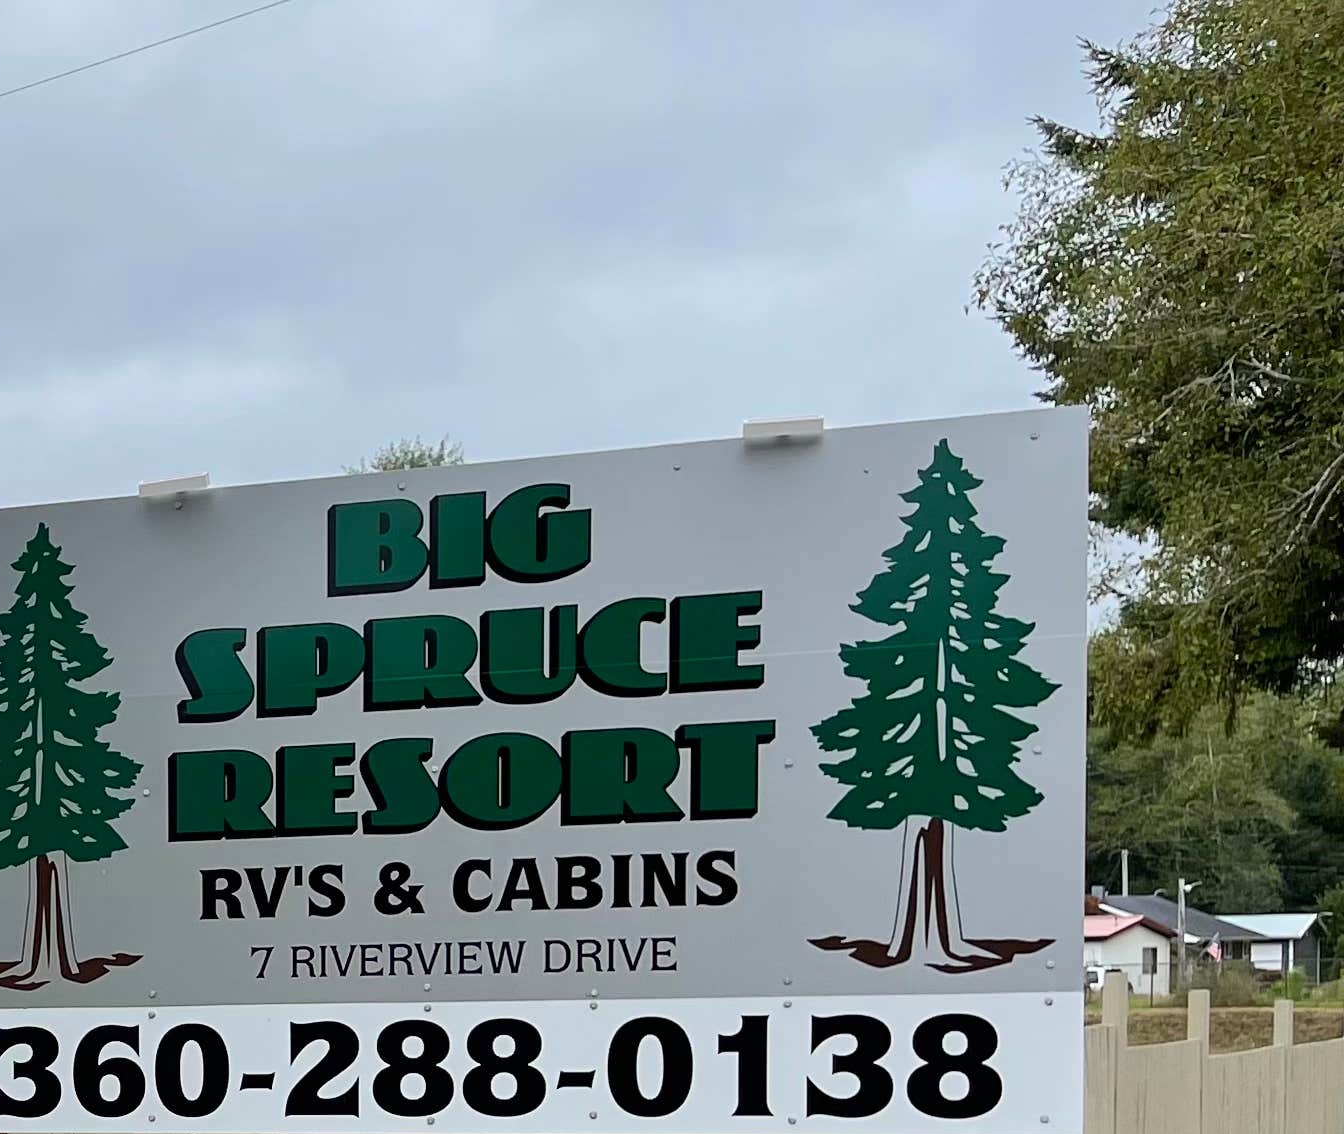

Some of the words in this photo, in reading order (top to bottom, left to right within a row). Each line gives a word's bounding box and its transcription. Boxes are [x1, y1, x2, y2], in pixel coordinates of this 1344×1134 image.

[327, 482, 592, 597] BIG
[174, 589, 766, 724] SPRUCE
[167, 719, 776, 842] RESORT
[198, 863, 347, 921] RV'S
[372, 861, 426, 916] &
[451, 849, 739, 914] CABINS
[249, 946, 275, 980] 7
[289, 939, 527, 979] RIVERVIEW
[542, 936, 679, 975] DRIVE
